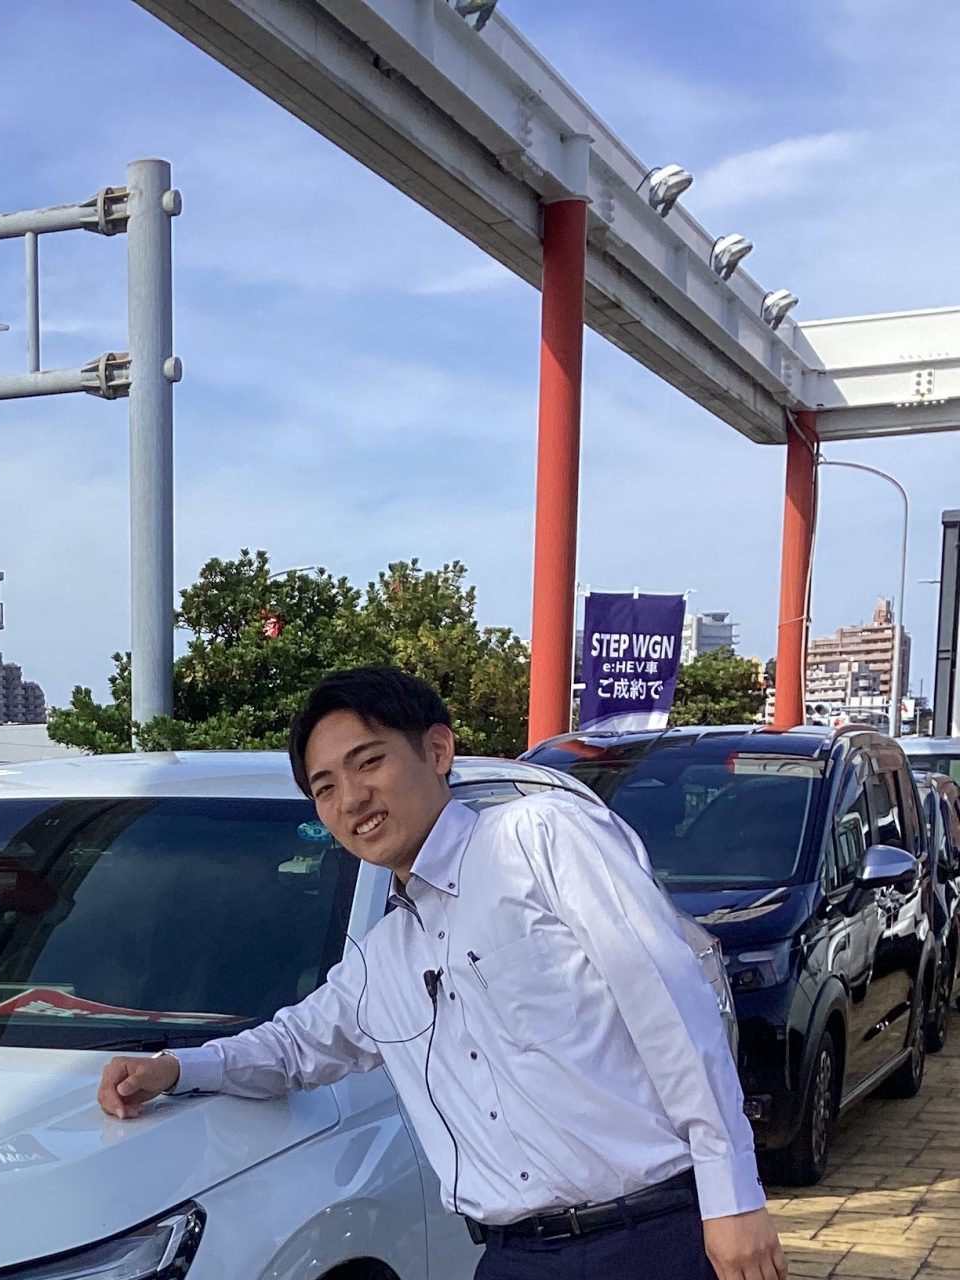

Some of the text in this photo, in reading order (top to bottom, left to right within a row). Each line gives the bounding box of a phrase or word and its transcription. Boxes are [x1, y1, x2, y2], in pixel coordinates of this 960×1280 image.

[591, 632, 675, 660] STEP WGN
[602, 660, 659, 675] e:HEV車
[597, 677, 664, 700] ご成約で
